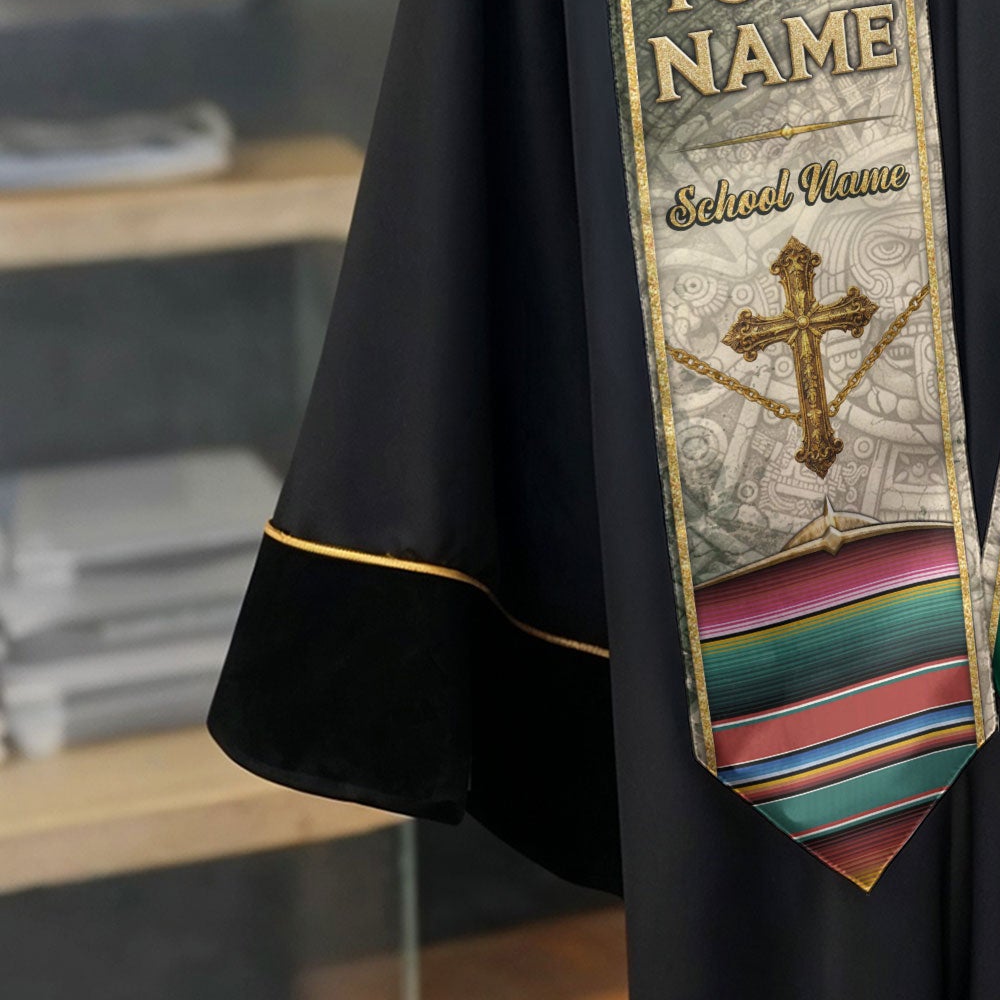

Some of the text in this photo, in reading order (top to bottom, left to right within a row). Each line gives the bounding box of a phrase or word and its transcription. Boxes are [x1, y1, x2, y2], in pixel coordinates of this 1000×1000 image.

[648, 3, 898, 103] NAME
[666, 160, 911, 231] School Name
